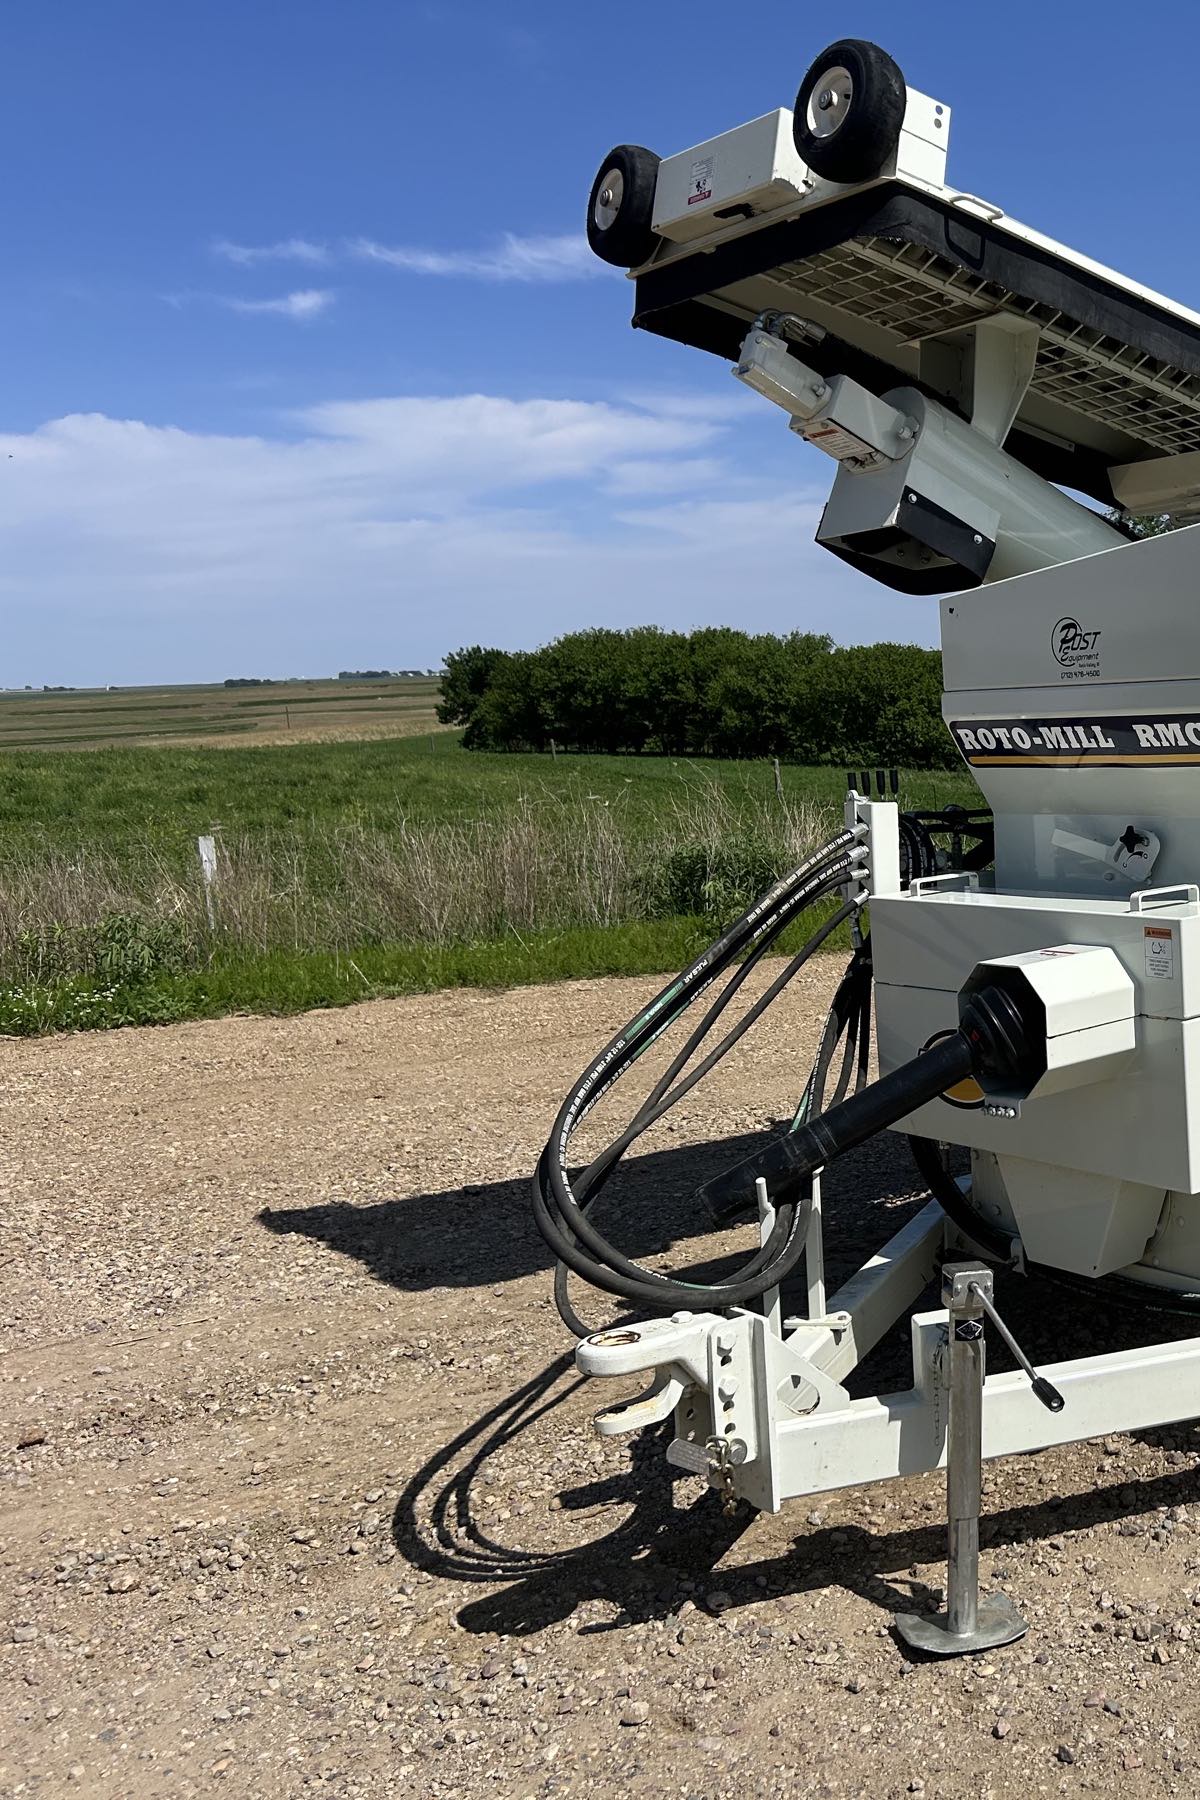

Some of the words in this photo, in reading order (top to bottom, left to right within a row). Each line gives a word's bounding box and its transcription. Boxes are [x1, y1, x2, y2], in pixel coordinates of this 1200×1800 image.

[1059, 622, 1101, 653] POST
[956, 725, 1115, 750] ROTO-MILL
[683, 959, 708, 983] PULSAR
